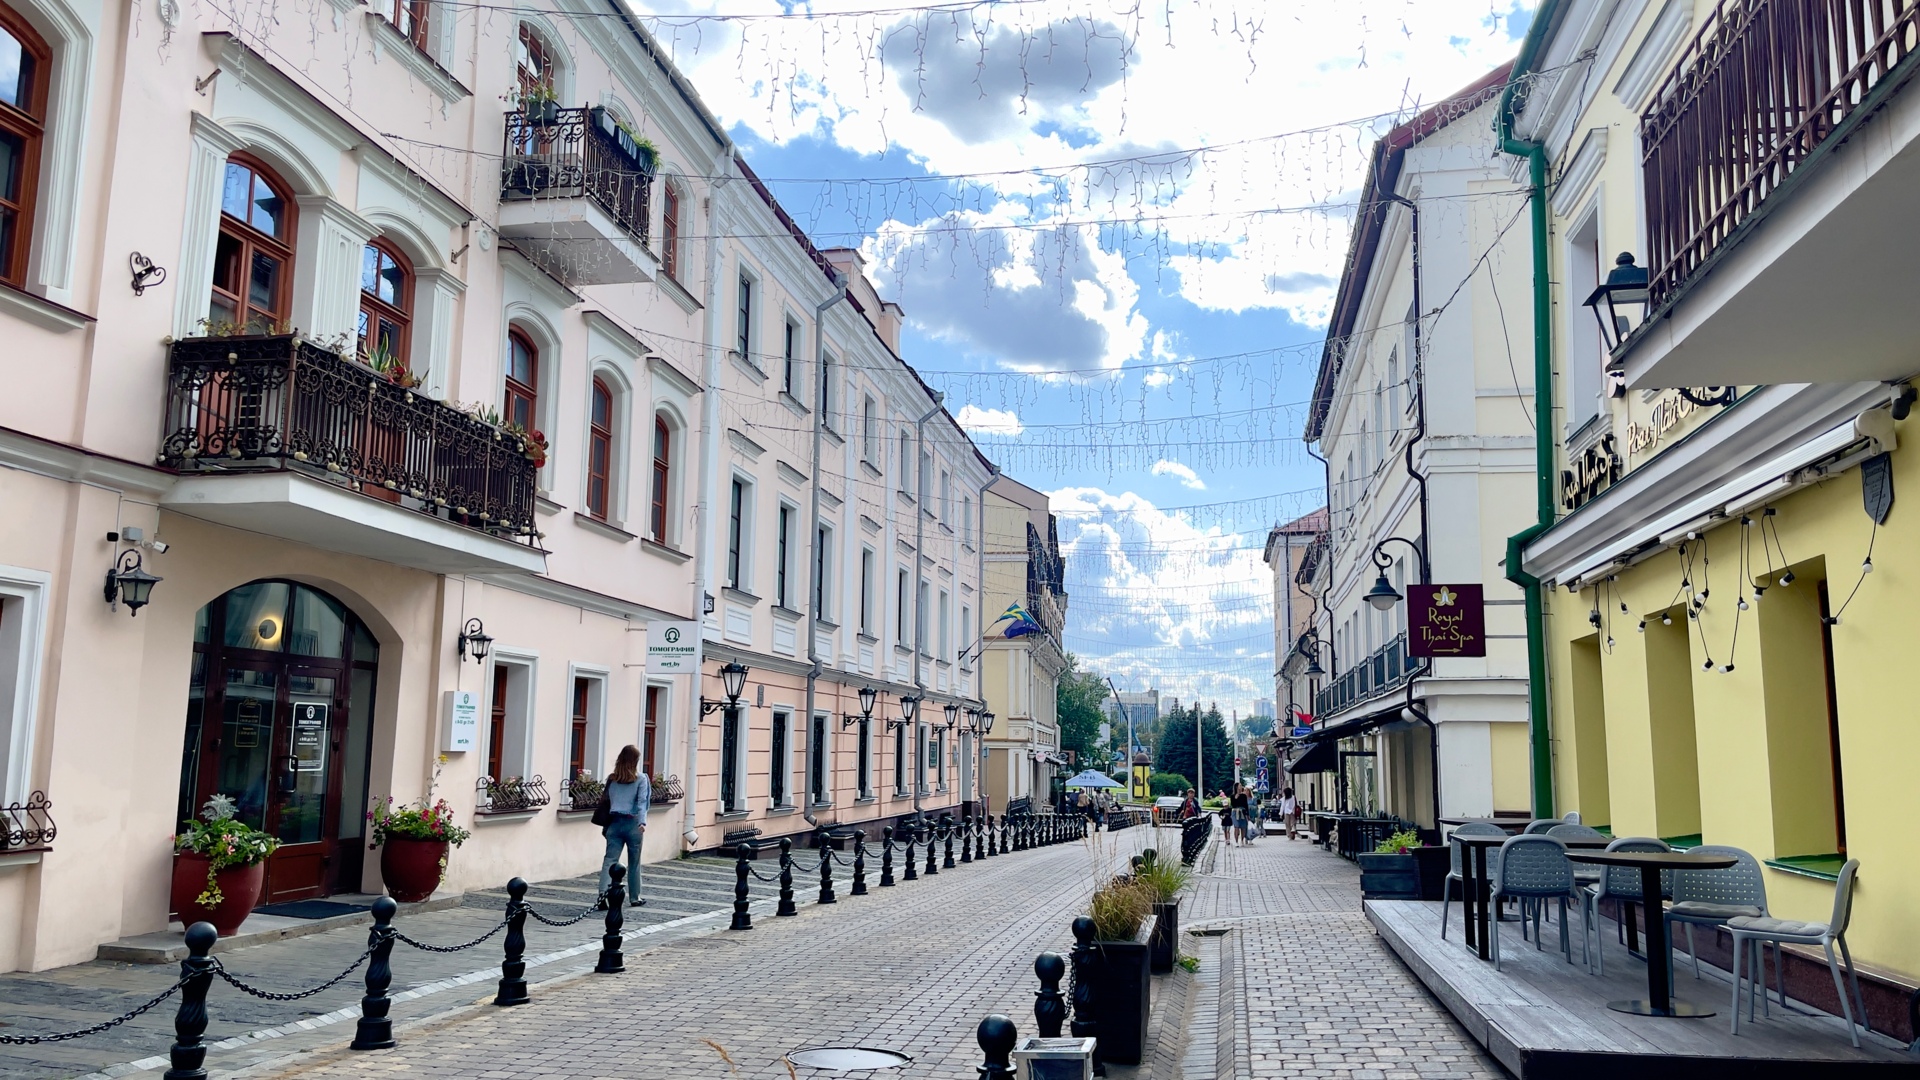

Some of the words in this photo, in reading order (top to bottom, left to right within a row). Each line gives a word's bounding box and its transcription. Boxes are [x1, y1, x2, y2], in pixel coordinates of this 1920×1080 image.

[1428, 607, 1463, 630] Royal
[1420, 626, 1447, 648] Thai
[1450, 626, 1474, 648] Spa
